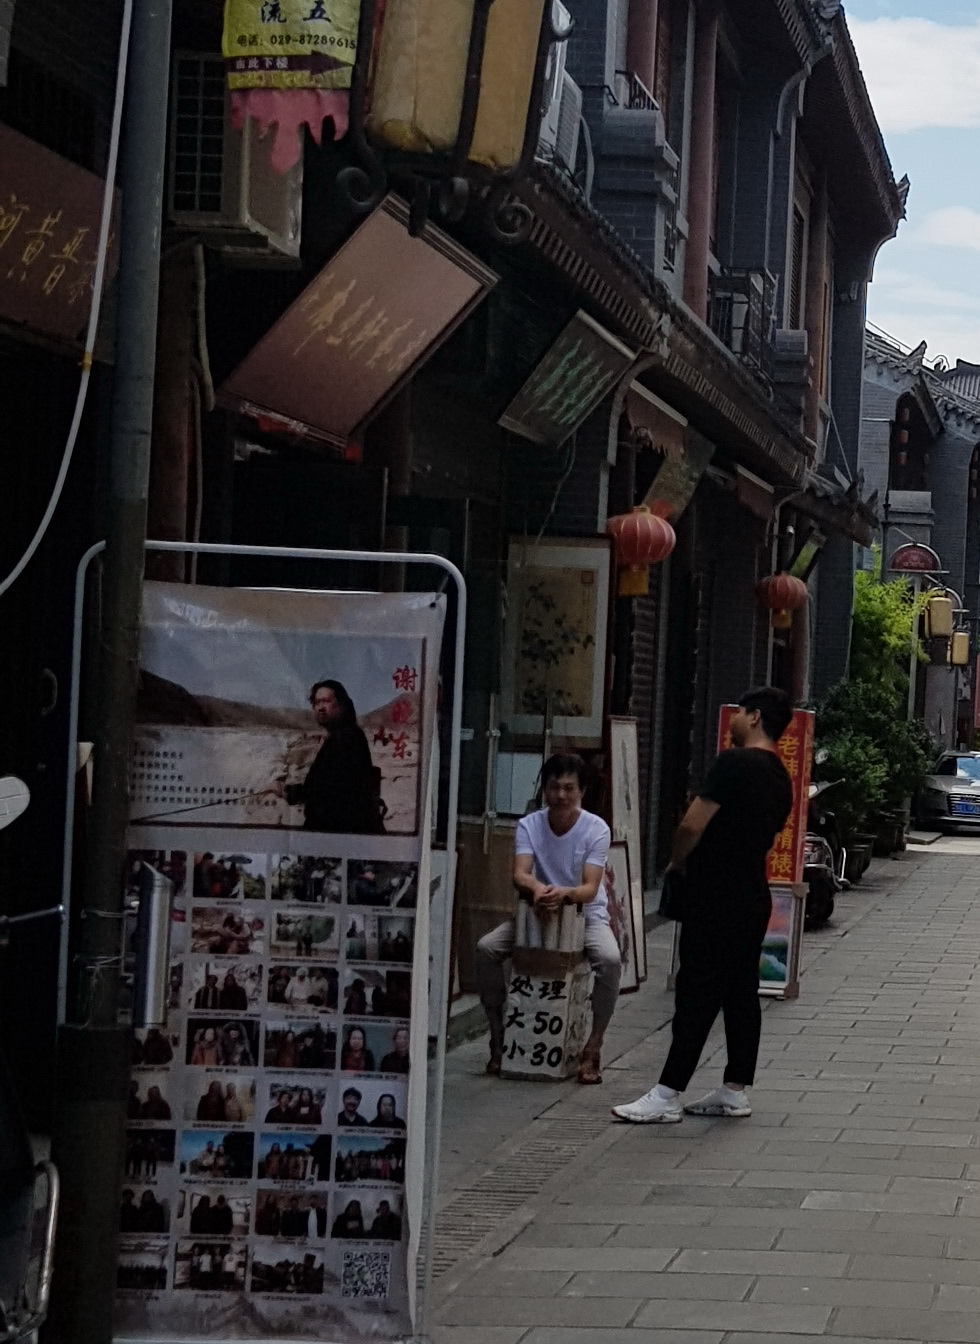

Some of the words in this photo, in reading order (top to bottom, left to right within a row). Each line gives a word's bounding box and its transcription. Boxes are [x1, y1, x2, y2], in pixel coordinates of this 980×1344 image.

[235, 57, 289, 70] 由此下楼
[509, 976, 567, 1001] 处理
[506, 1007, 525, 1029] 大
[533, 1011, 563, 1035] 50
[502, 1039, 526, 1060] 小
[530, 1042, 562, 1067] 30
